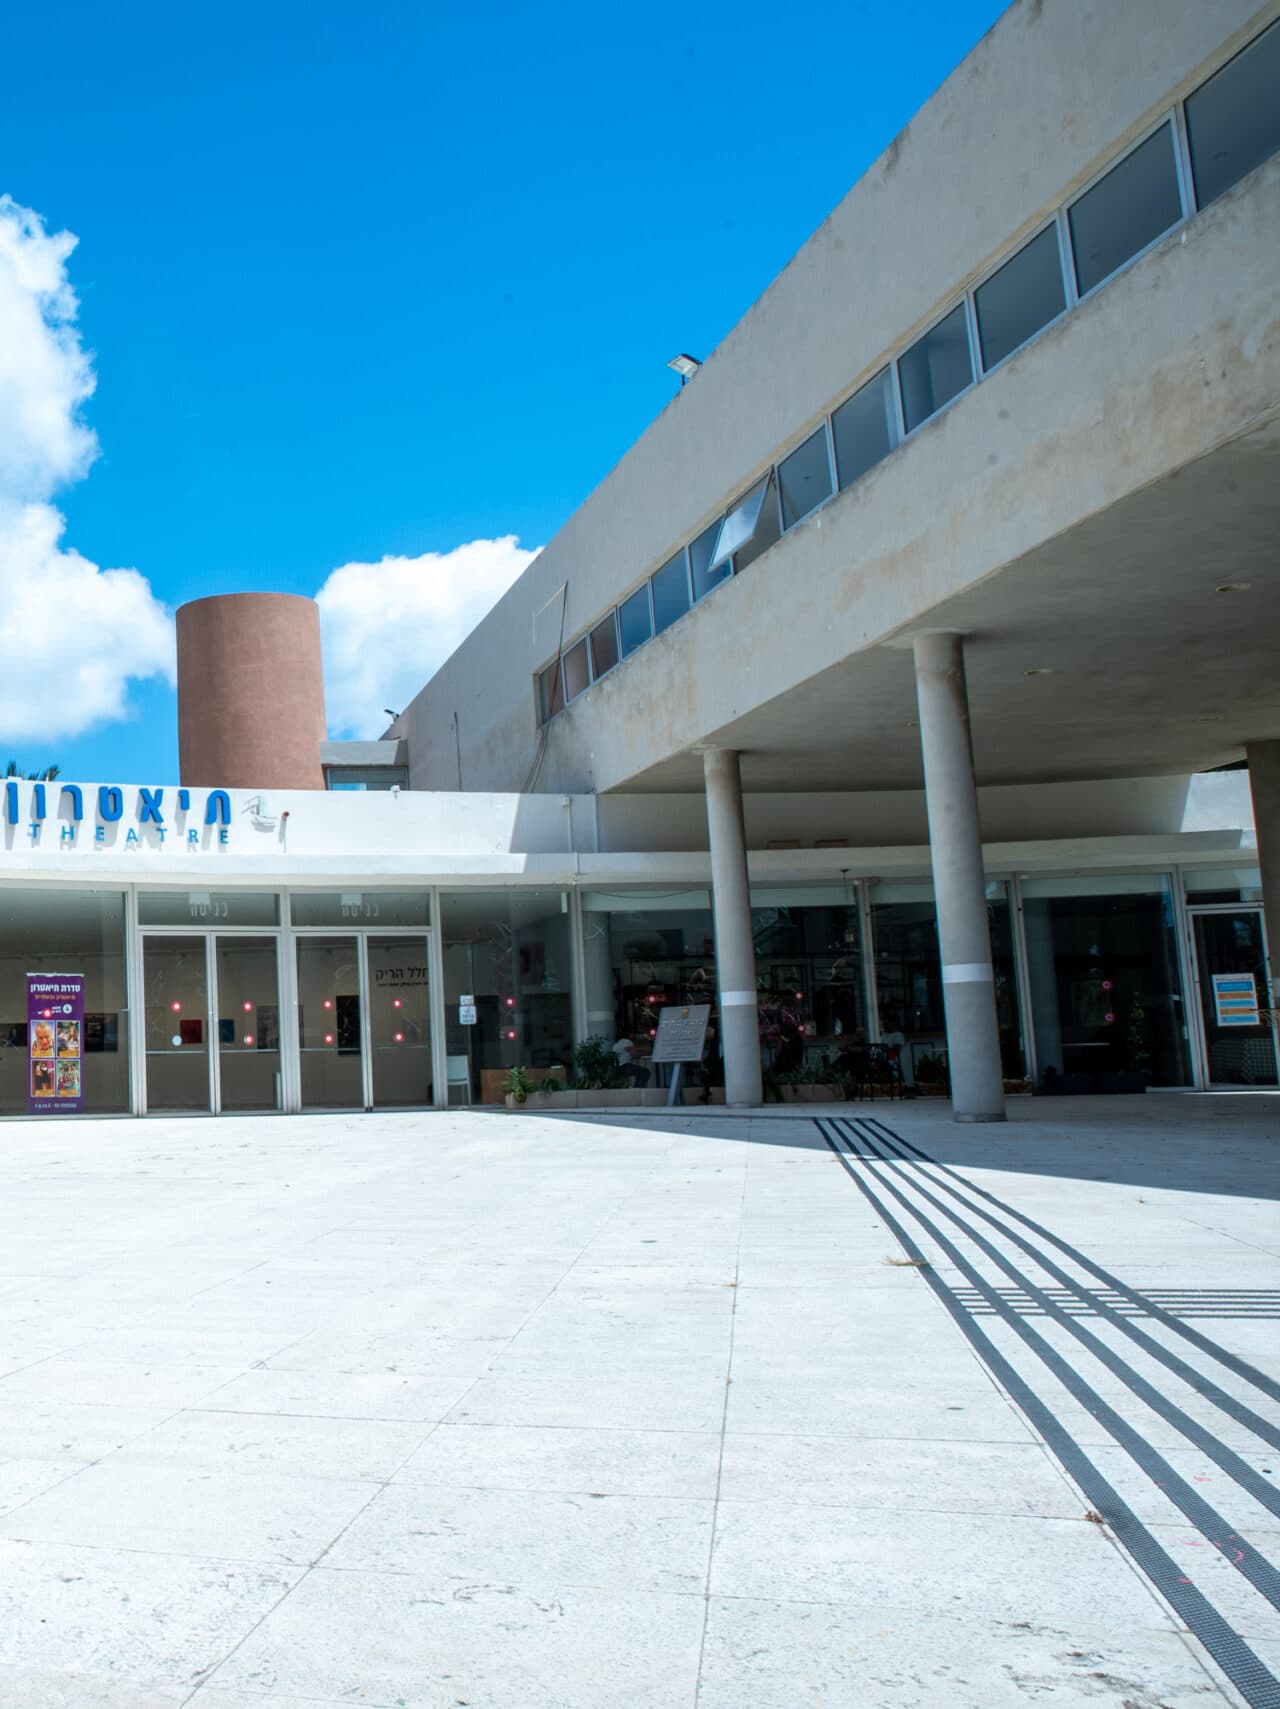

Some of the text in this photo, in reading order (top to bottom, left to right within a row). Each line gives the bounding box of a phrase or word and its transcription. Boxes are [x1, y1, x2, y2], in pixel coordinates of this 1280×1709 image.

[6, 782, 232, 825] תיאטרון
[29, 822, 229, 845] THEATRE
[376, 968, 403, 982] הריק
[30, 983, 81, 993] סדרת תיאטרון
